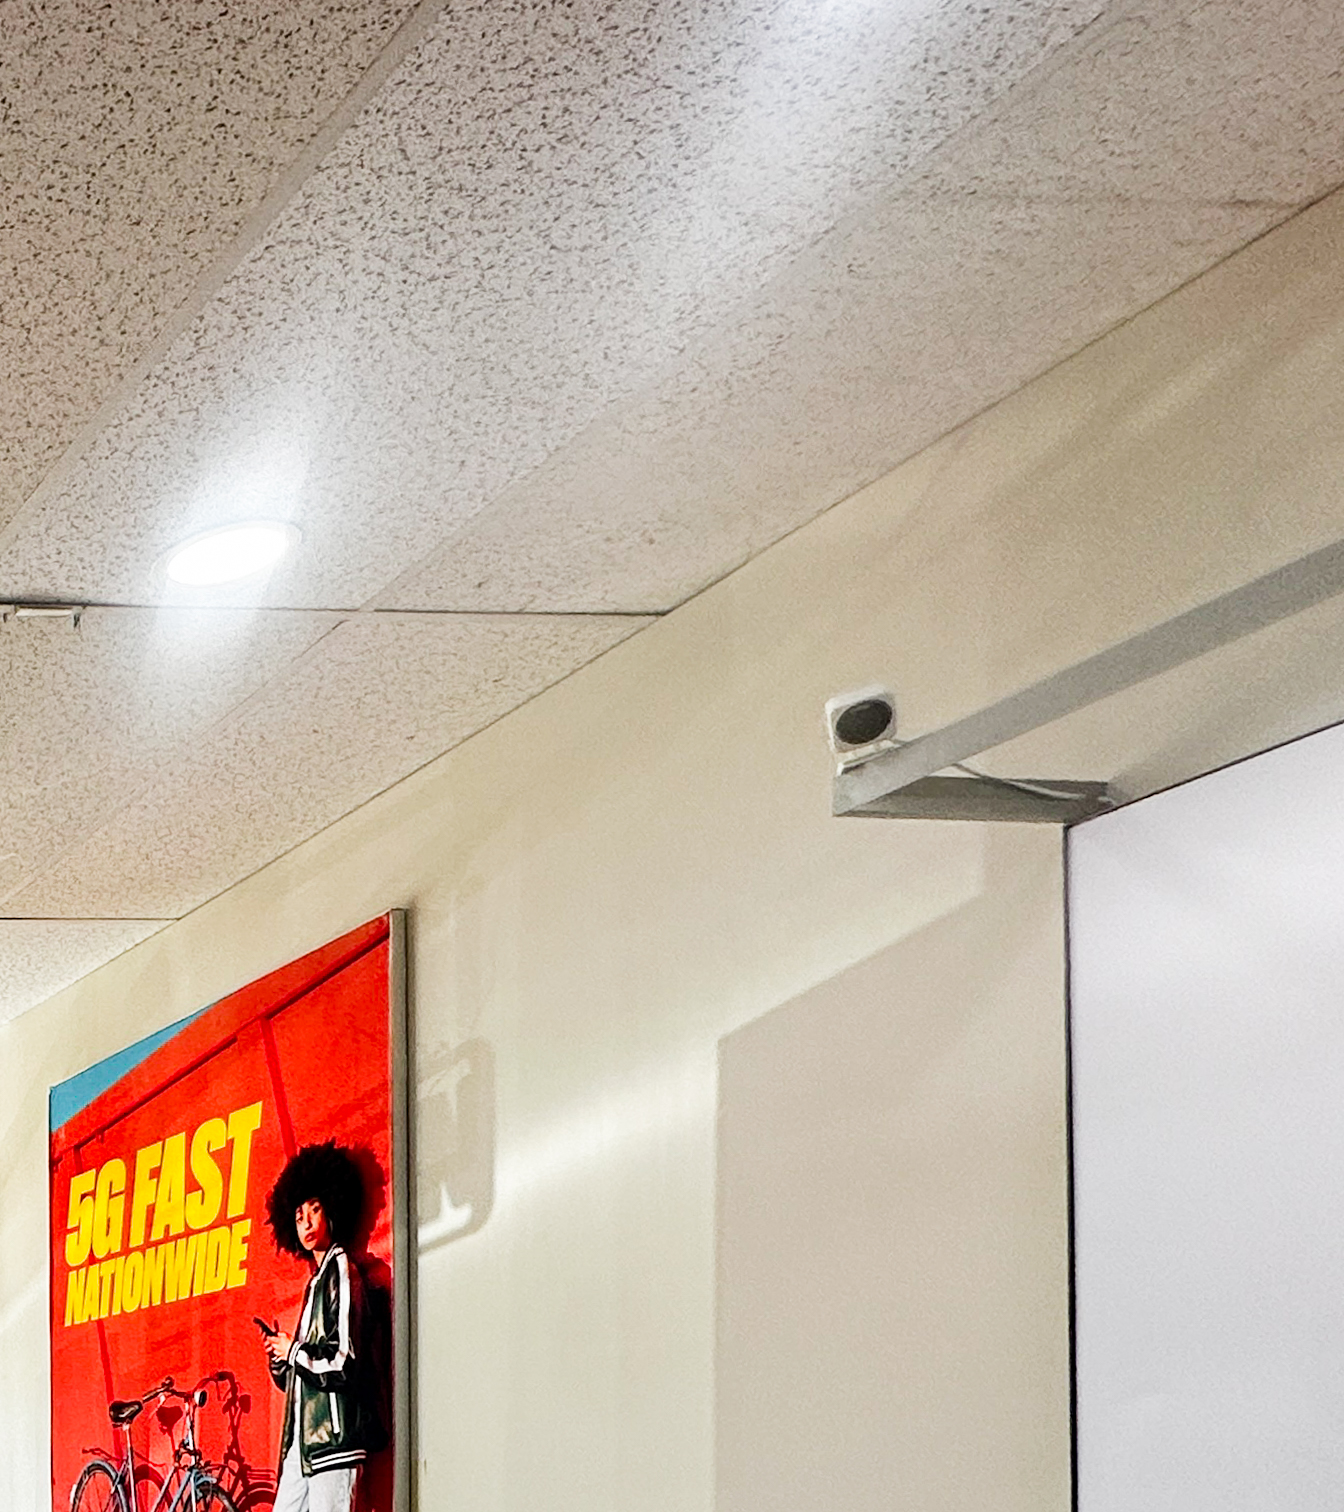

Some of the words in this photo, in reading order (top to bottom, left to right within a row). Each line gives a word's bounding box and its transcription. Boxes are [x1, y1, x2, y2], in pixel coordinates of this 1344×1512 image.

[65, 1158, 126, 1267] 5G
[129, 1101, 262, 1248] FAST
[64, 1218, 251, 1327] NATIONWIDE
